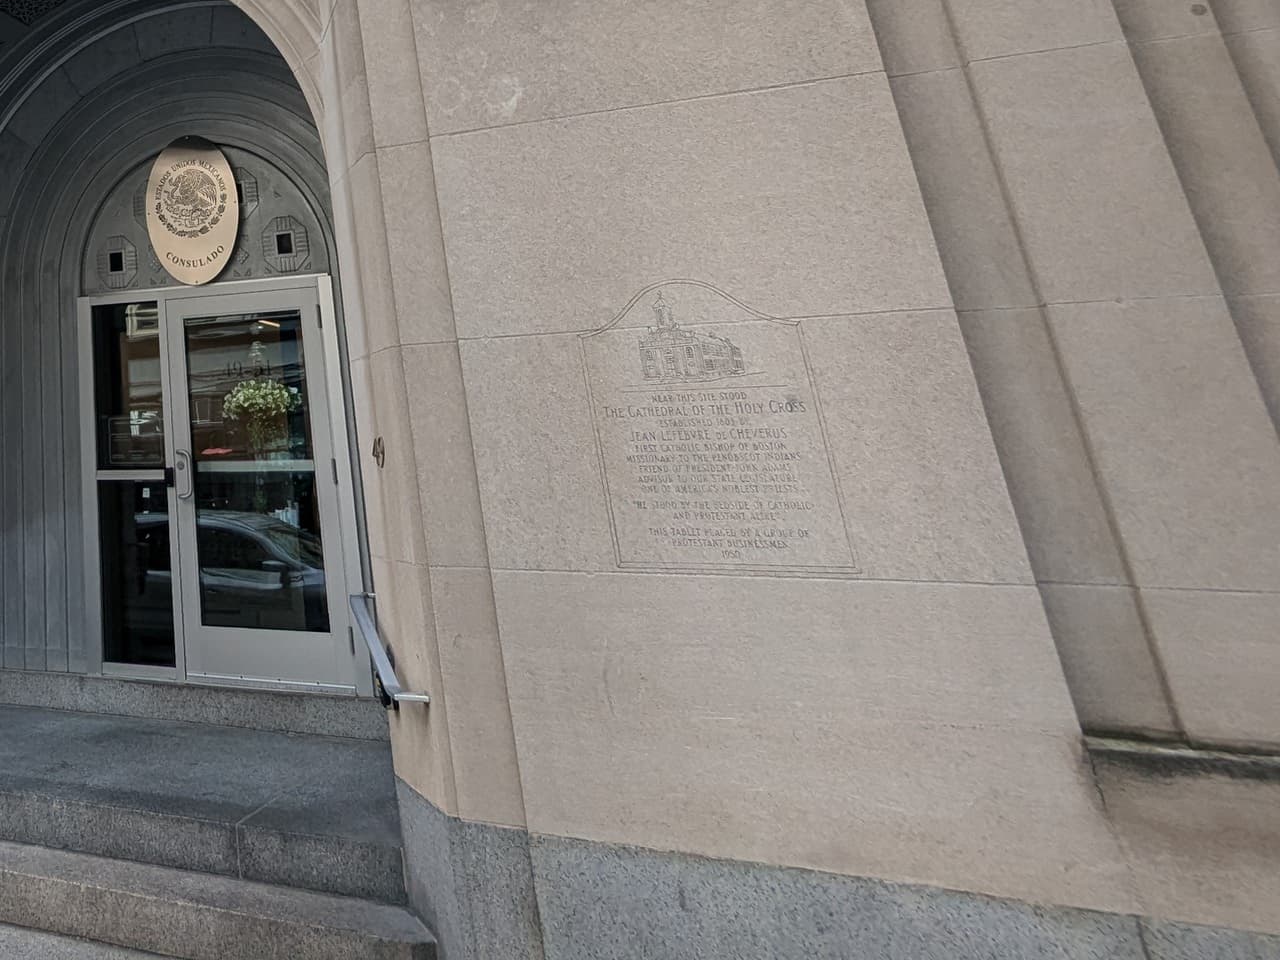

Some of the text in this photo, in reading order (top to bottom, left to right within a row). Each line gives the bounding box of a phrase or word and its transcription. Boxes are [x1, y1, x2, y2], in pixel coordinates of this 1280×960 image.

[155, 160, 226, 200] ESTADOS UNIDOS MEXICANOS
[166, 245, 224, 268] CONSULADO
[651, 391, 747, 402] NEAR THIS SITE STOOD
[602, 399, 807, 418] THE CATHEDRAL OF THE HOLY CROSS
[630, 431, 657, 442] JEAN
[661, 429, 711, 441] LEFEBVRE
[730, 428, 787, 440] CHEVERUS
[634, 444, 657, 453] FIRST
[661, 443, 699, 453] CATHOLIC
[704, 442, 734, 452] BISHOP
[753, 441, 787, 451] BOSTON
[626, 453, 674, 463] MISSIONARY
